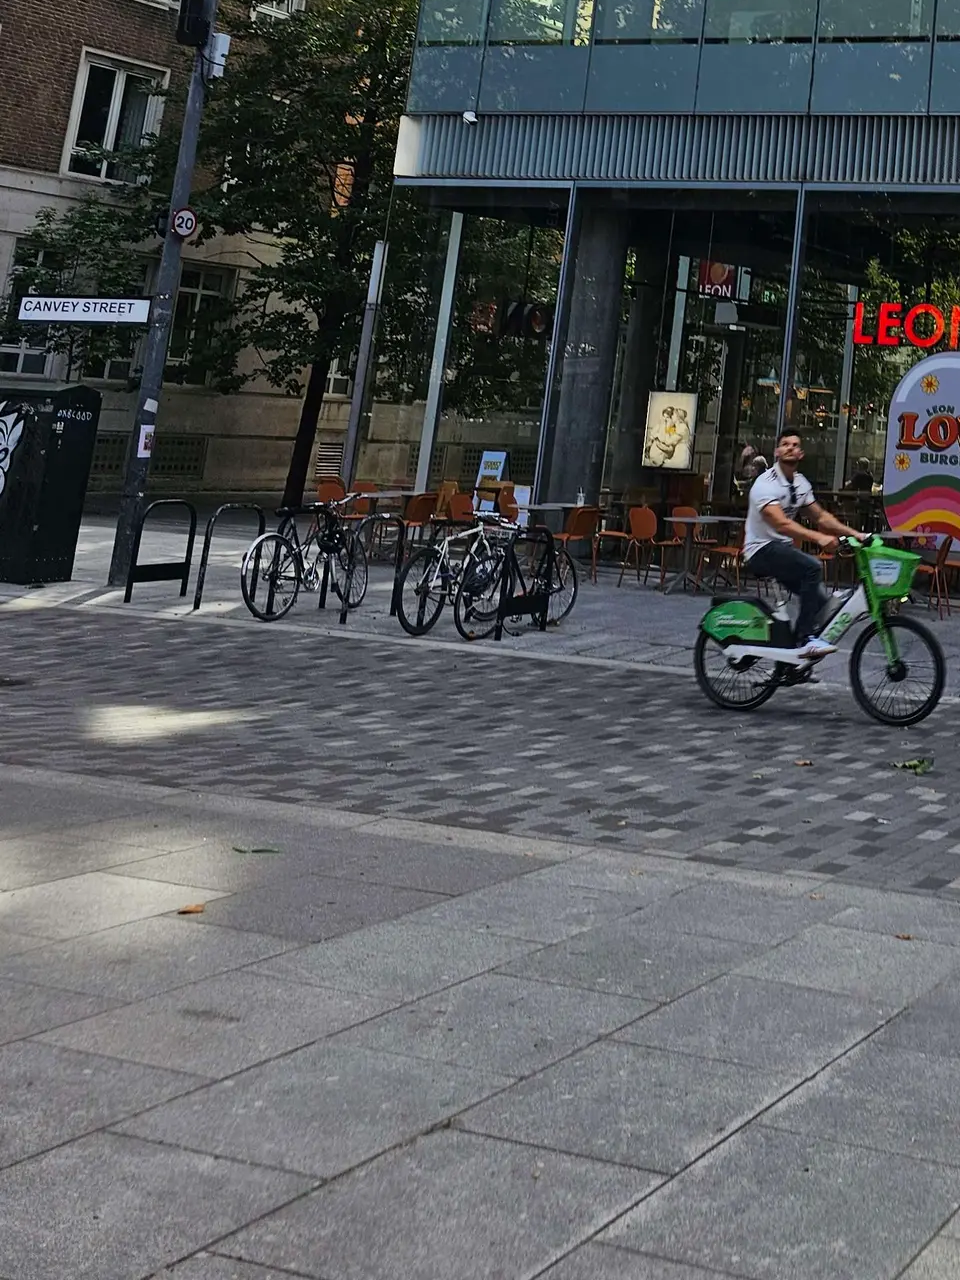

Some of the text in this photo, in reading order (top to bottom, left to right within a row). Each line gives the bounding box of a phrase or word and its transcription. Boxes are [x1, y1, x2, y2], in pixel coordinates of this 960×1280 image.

[176, 215, 193, 230] 20
[699, 284, 732, 298] LEON
[23, 300, 135, 314] CANVEY STREET
[926, 405, 955, 417] LEON
